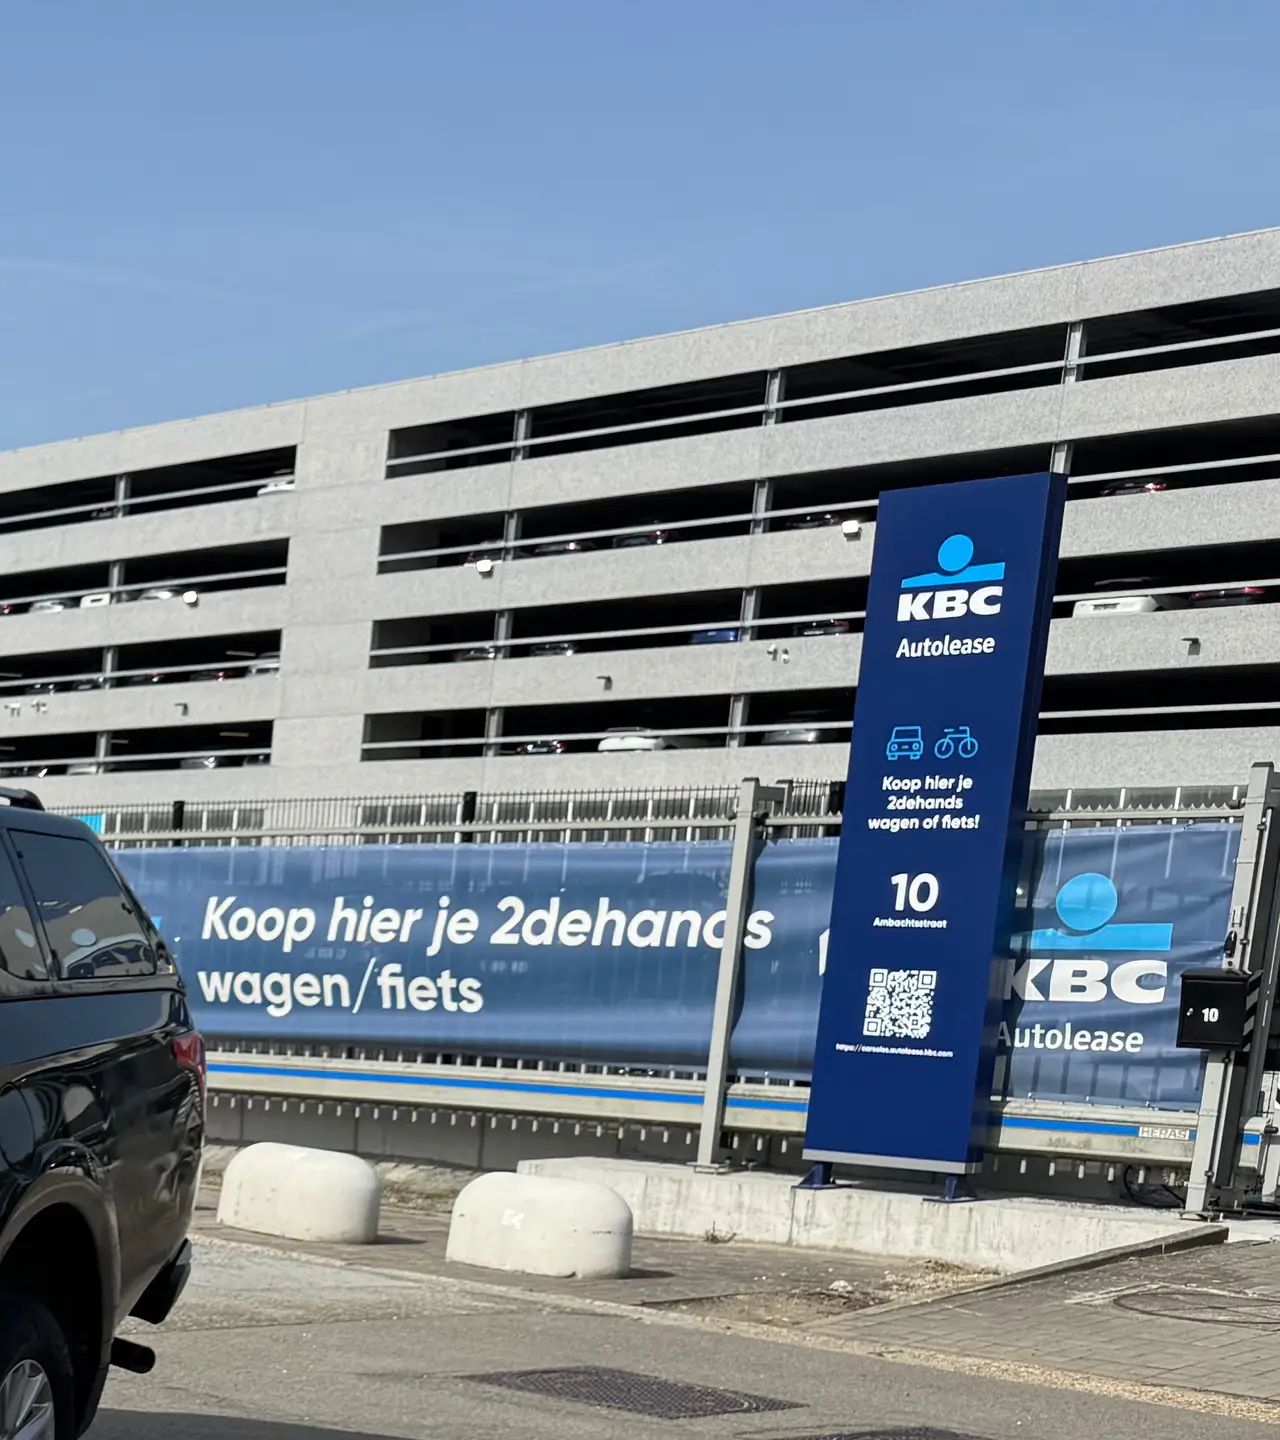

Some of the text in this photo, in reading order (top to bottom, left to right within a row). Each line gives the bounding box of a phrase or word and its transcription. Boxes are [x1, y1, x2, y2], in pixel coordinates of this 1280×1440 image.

[897, 586, 1003, 622] KBC
[895, 634, 995, 658] Autolease
[882, 774, 973, 793] Koop hier je
[887, 795, 963, 810] 2dehands
[868, 814, 980, 832] wagen of fiets!
[891, 873, 939, 912] 10
[201, 896, 315, 945] Koop
[327, 896, 422, 945] hier
[427, 895, 478, 957] je
[873, 917, 947, 928] Ambachtsstraat
[1003, 958, 1168, 1004] KBC
[1202, 1008, 1219, 1022] 10
[996, 1020, 1144, 1052] Autolease
[1140, 1126, 1187, 1140] HERAS
